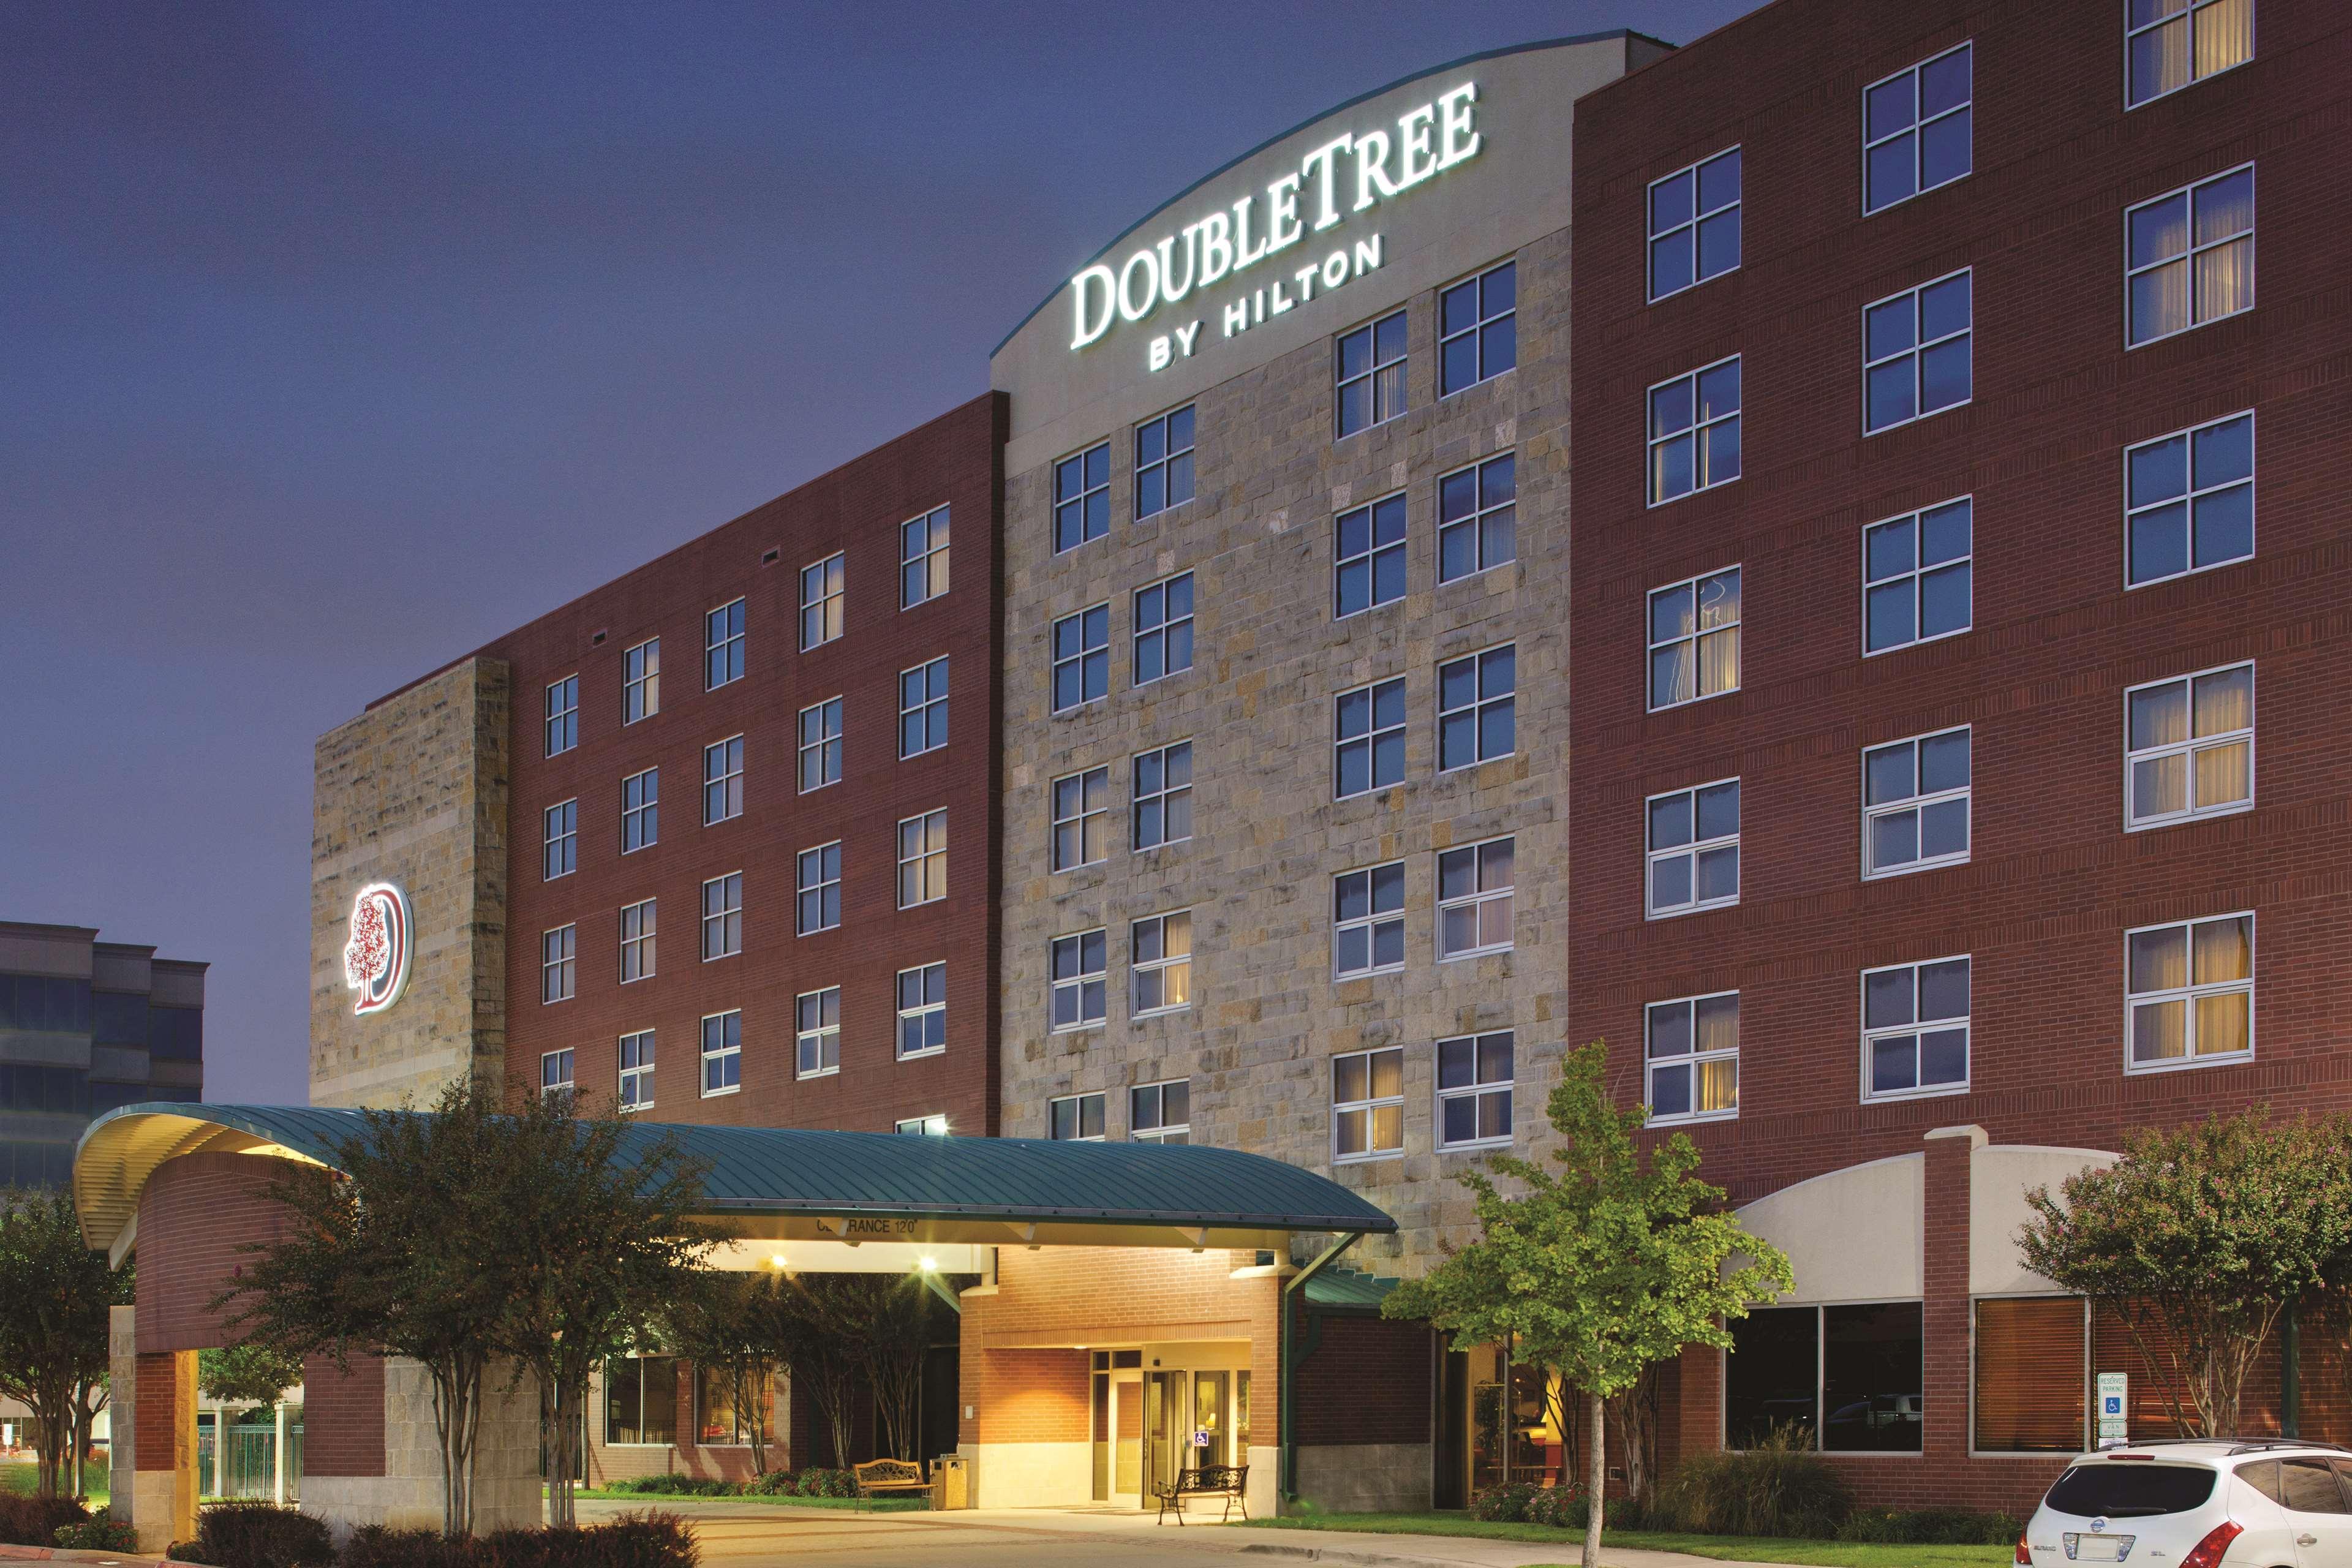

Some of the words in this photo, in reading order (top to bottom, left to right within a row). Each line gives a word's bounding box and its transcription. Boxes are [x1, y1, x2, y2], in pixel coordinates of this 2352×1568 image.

[1150, 320, 1202, 371] BY
[1224, 233, 1382, 337] HILTON
[817, 1219, 890, 1233] CRANCE
